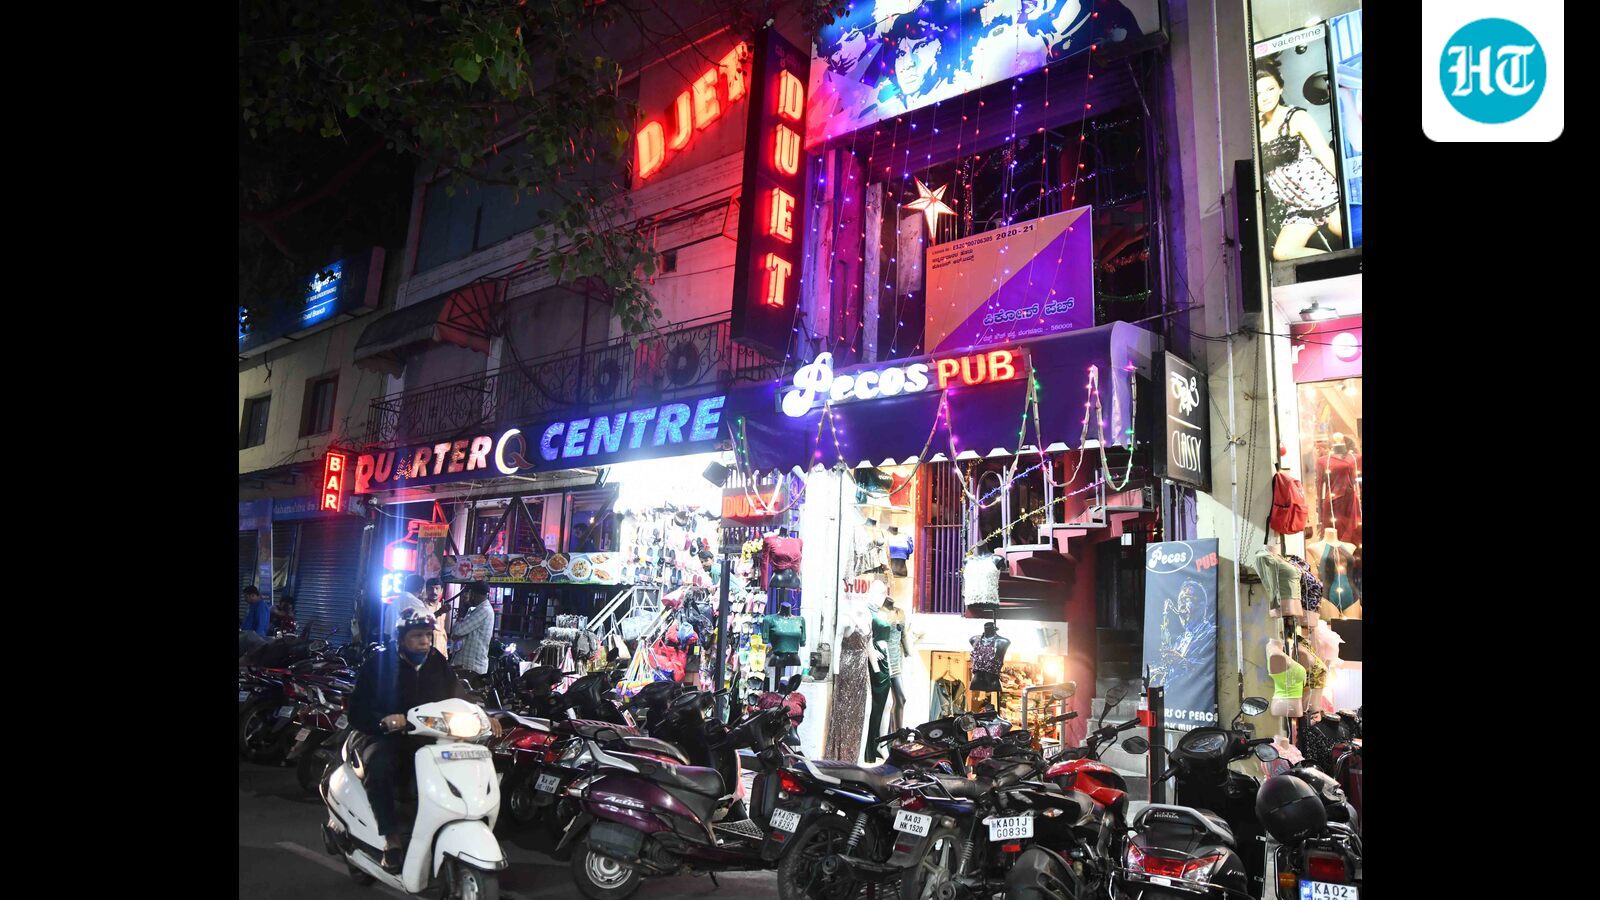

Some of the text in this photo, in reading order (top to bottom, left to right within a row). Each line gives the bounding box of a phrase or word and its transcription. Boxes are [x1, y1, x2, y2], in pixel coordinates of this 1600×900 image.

[766, 68, 804, 308] DUET
[782, 350, 1015, 418] Pecos PUB
[355, 435, 493, 491] QUARTER
[540, 395, 726, 461] CENTRE
[325, 456, 342, 510] BAR
[1148, 546, 1218, 573] Pecos PUB
[1174, 709, 1187, 719] OF
[904, 814, 922, 824] KA 03
[910, 824, 924, 834] 1520
